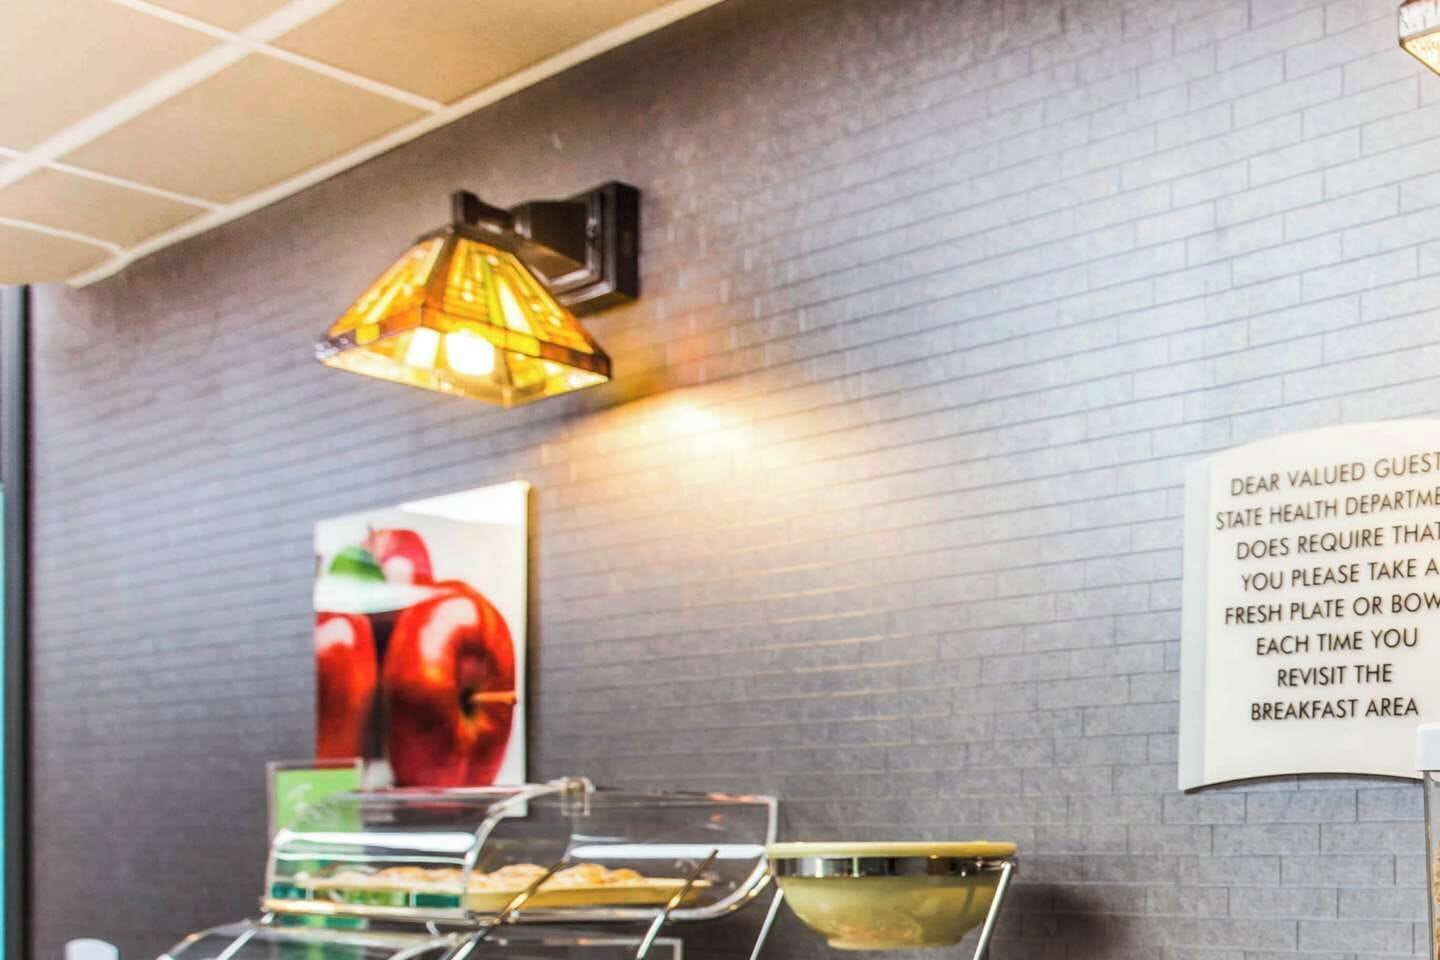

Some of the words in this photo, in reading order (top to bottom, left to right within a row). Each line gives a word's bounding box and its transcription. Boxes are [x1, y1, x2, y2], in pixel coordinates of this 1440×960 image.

[1231, 473, 1280, 497] DEAR
[1287, 462, 1366, 488] VALUED
[1216, 507, 1262, 530] STATE
[1269, 500, 1337, 525] HEALTH
[1236, 537, 1289, 560] DOES
[1297, 527, 1384, 554] REQUIRE
[1241, 571, 1284, 592] YOU
[1291, 564, 1360, 588] PLEASE
[1368, 558, 1417, 581] TAKE
[1424, 558, 1440, 576] A
[1224, 603, 1282, 625] FRESH
[1290, 599, 1345, 620] PLATE
[1353, 596, 1383, 616] OR
[1256, 635, 1309, 656] EACH
[1316, 631, 1363, 652] TIME
[1370, 627, 1418, 649] YOU
[1277, 666, 1347, 687] REVISIT
[1354, 663, 1392, 684] THE
[1251, 699, 1359, 721] BREAKFAST
[1365, 698, 1419, 717] AREA
